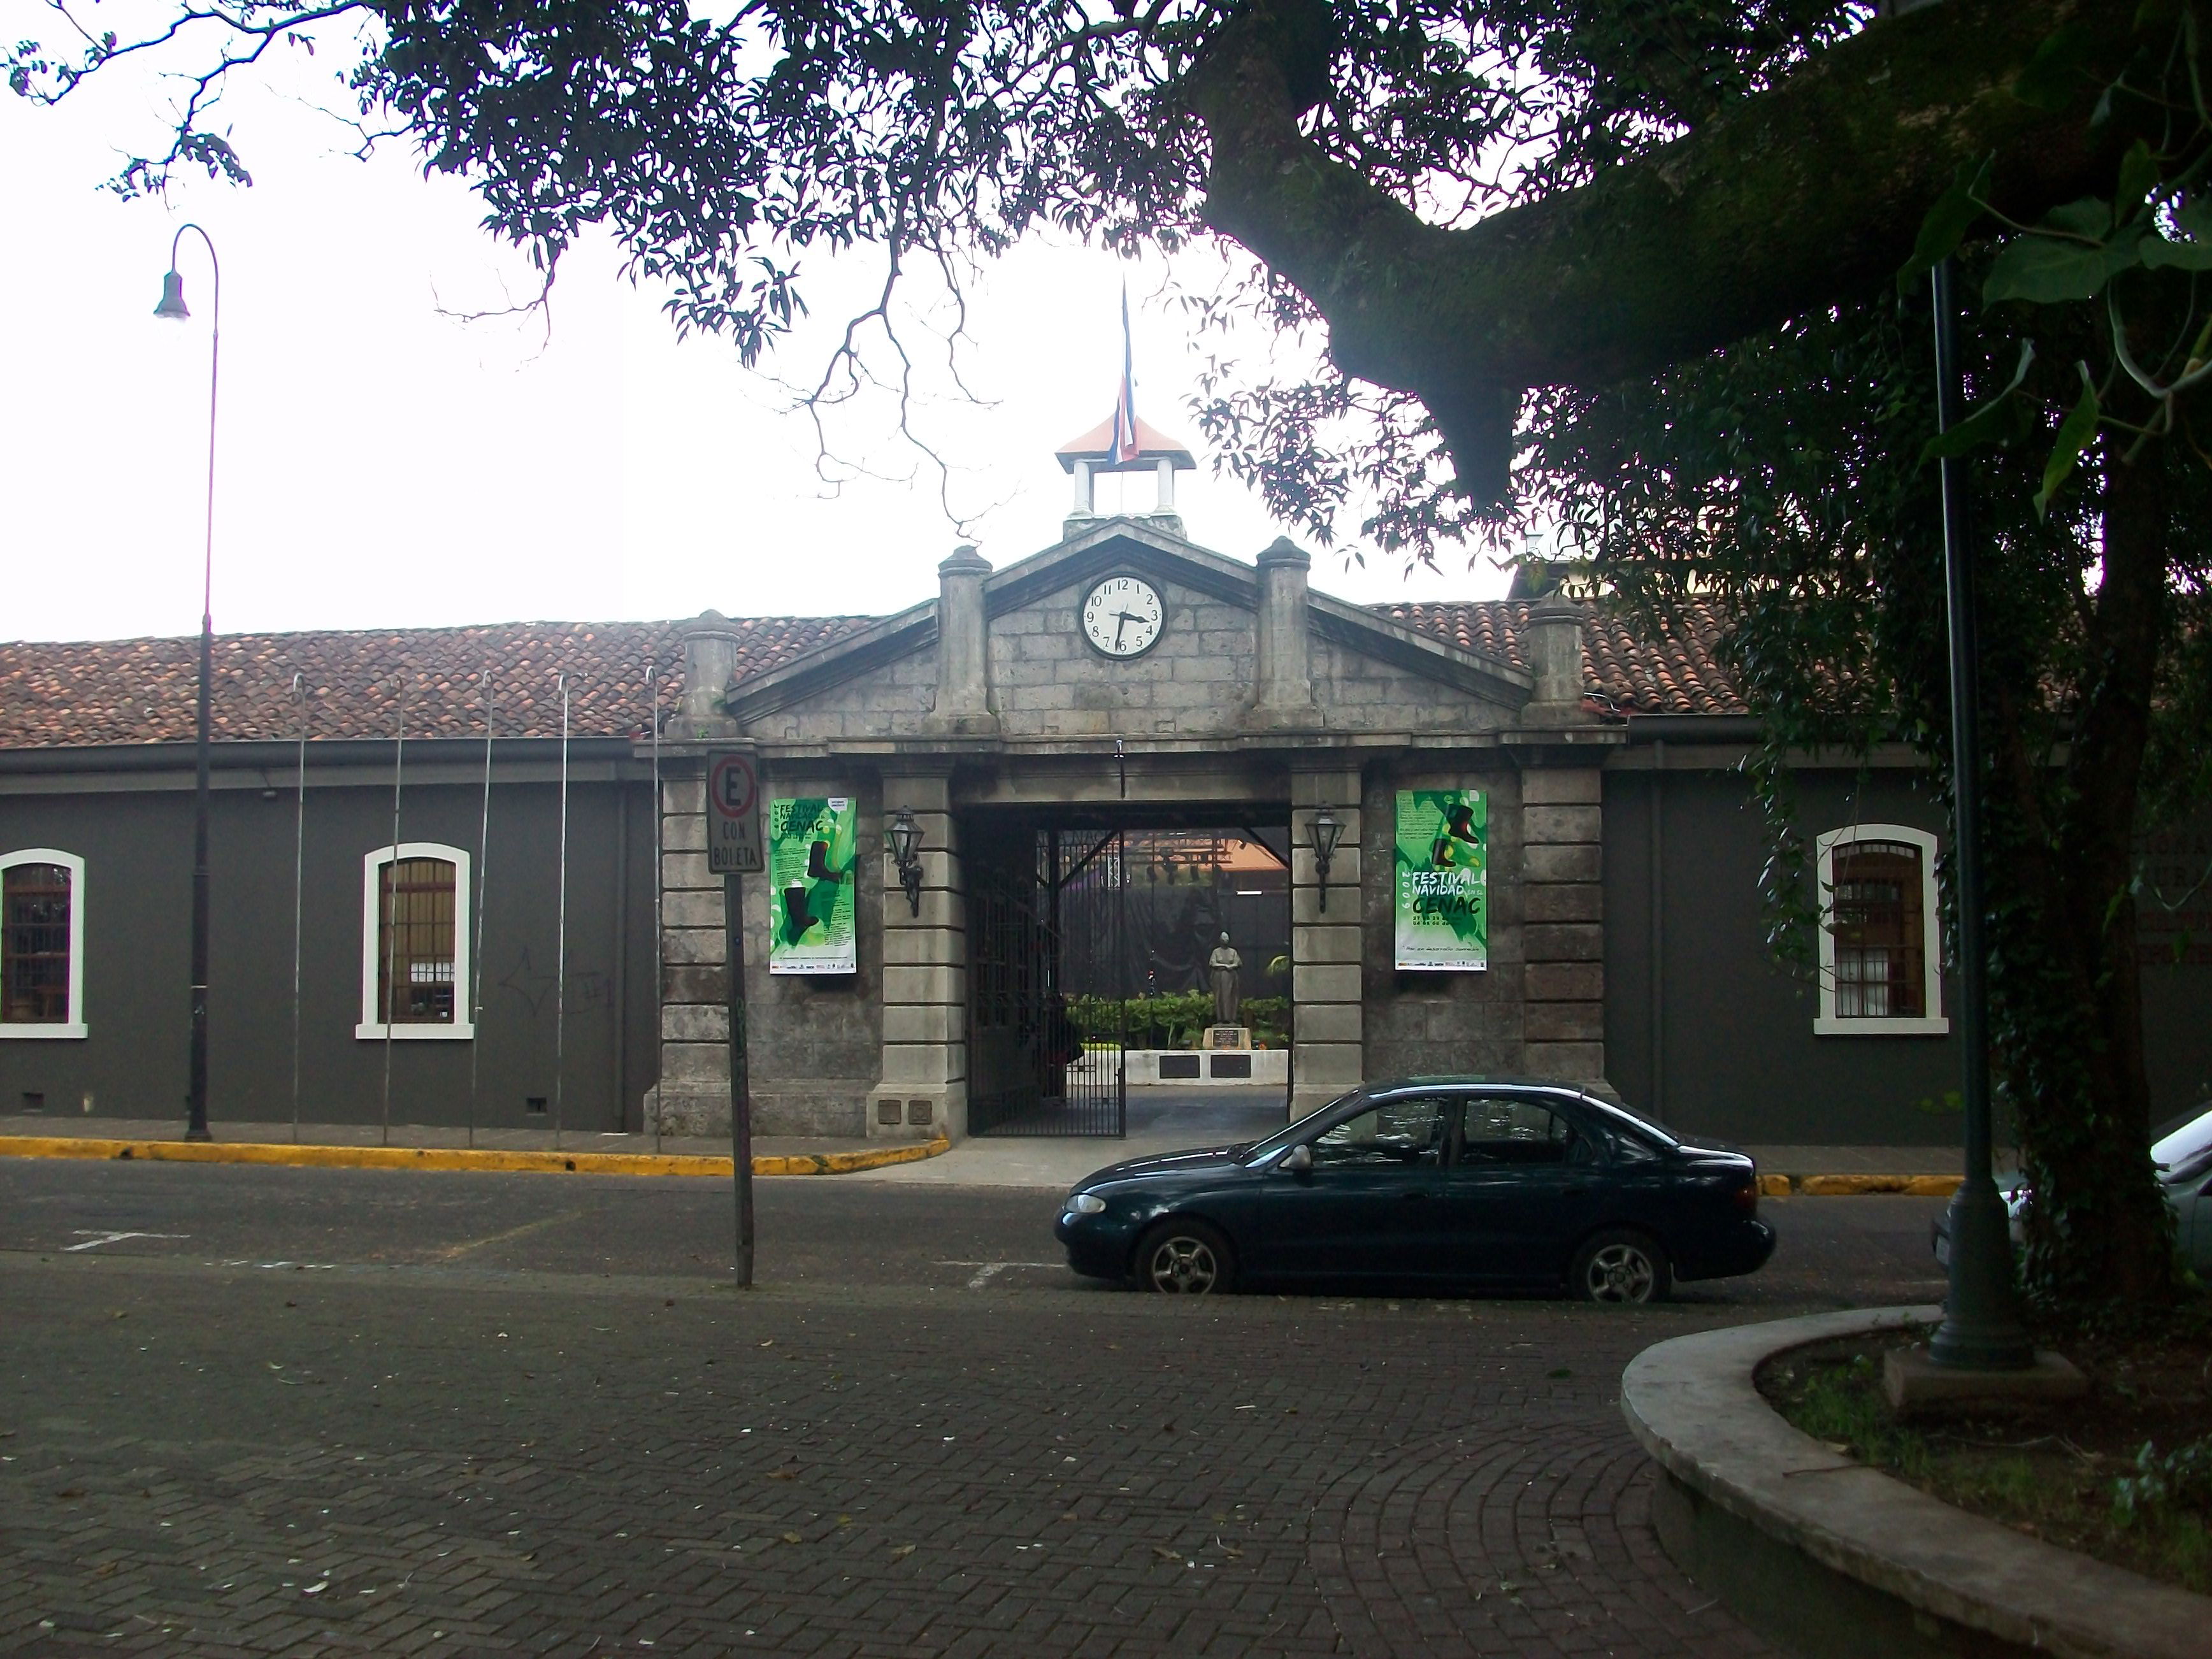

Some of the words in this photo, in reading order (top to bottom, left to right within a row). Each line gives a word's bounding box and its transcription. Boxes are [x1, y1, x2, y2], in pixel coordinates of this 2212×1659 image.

[1103, 584, 1112, 595] 11
[1117, 579, 1128, 591] 12
[1137, 584, 1140, 594] 1
[1091, 596, 1102, 607] 10
[1146, 594, 1153, 605] 2
[1086, 612, 1095, 622] 9
[1151, 610, 1158, 621] 3
[1092, 626, 1100, 637] 8
[1145, 625, 1153, 636] 4
[1103, 636, 1110, 647] 7
[1119, 640, 1127, 651] 6
[1136, 636, 1143, 647] 5
[725, 766, 741, 806] E
[723, 821, 745, 840] CON
[780, 820, 824, 833] CENAC
[714, 847, 758, 866] BOLETA
[1412, 872, 1480, 886] FESTIVAL
[1401, 871, 1411, 909] 2009
[1412, 884, 1465, 896] NAVIDAD
[1412, 896, 1481, 916] CENAC
